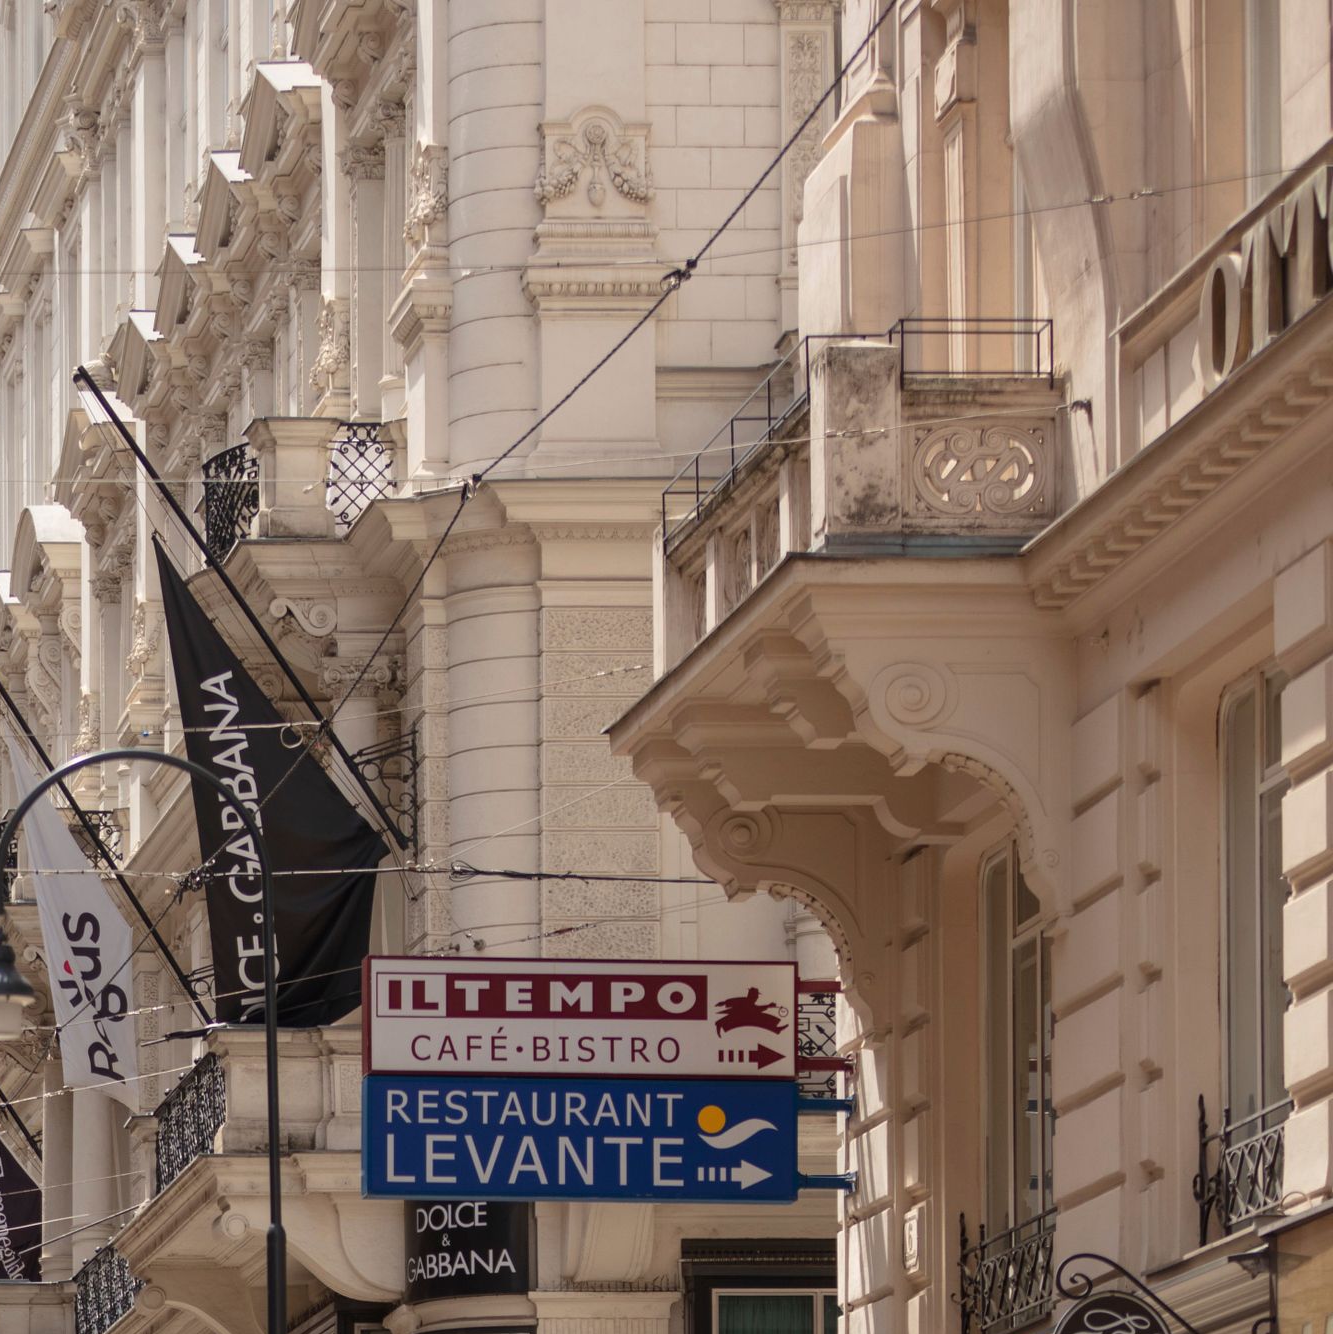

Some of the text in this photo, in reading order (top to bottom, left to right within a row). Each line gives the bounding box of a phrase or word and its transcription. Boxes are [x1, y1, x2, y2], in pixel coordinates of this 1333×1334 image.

[388, 979, 697, 1014] IL TEMPO
[386, 1090, 685, 1128] RESTAURANT
[386, 1133, 685, 1188] LEVANTE
[416, 1202, 488, 1233] DOLCE
[441, 1233, 451, 1246] &
[407, 1248, 516, 1283] GABBANA
